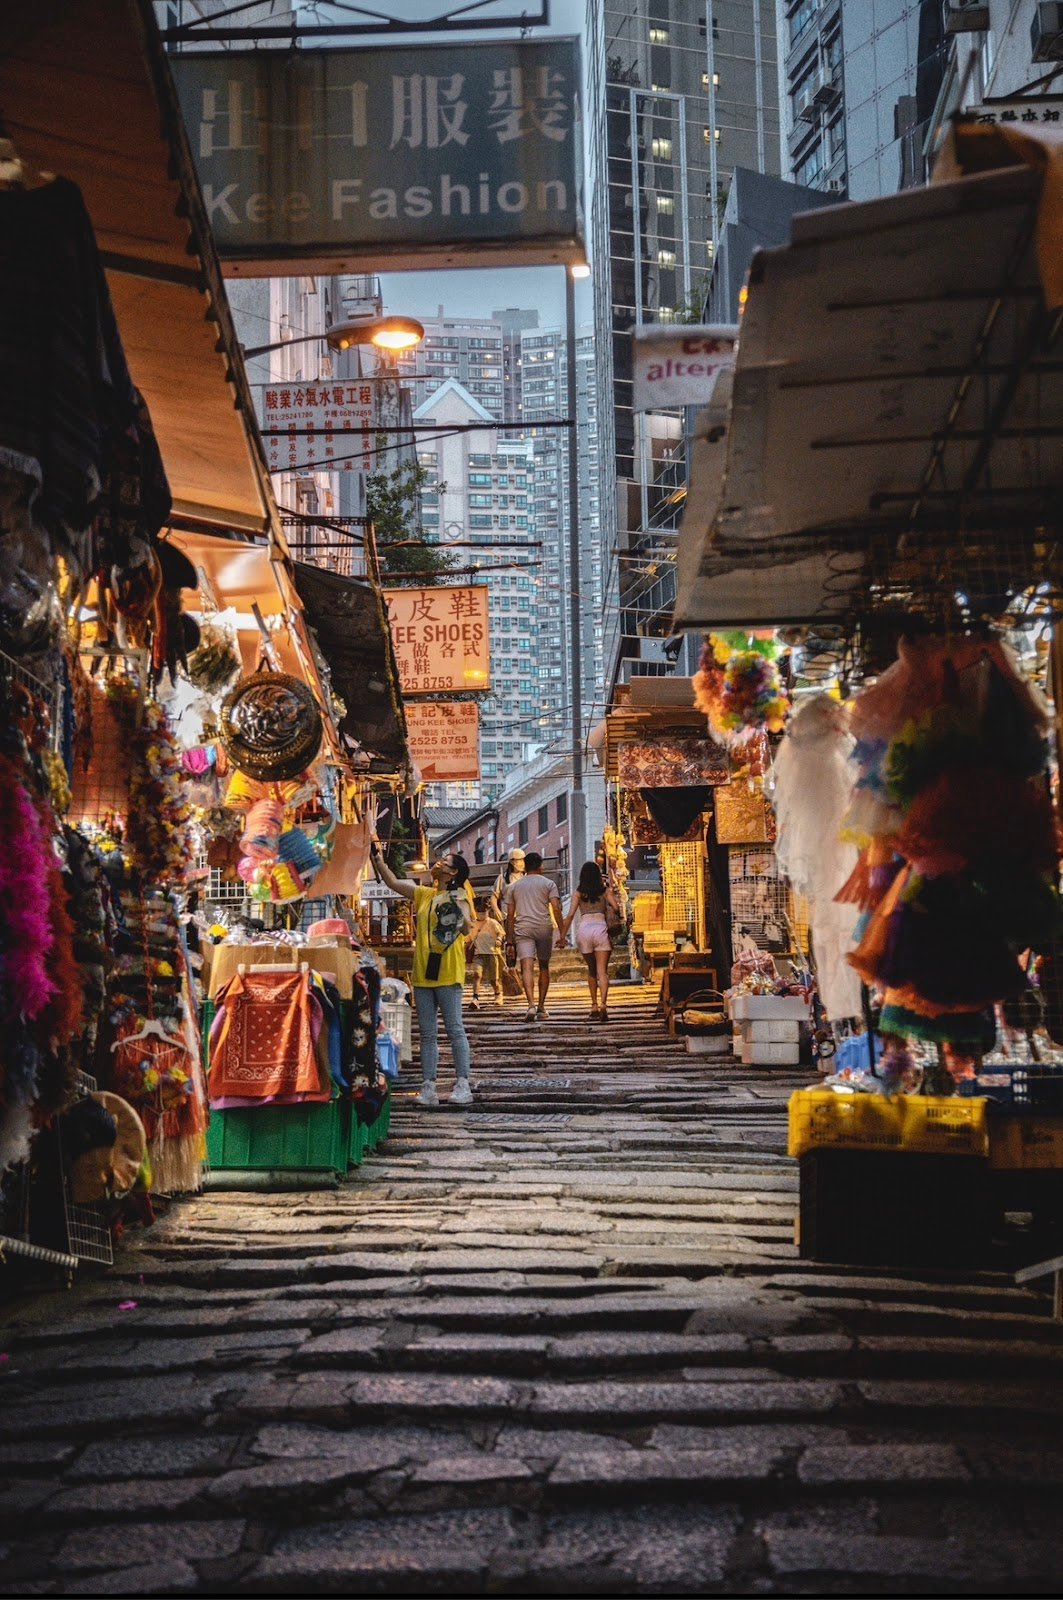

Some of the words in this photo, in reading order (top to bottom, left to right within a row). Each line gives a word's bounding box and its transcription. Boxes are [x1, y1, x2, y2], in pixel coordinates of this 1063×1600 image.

[203, 182, 312, 226] Kee
[331, 172, 568, 221] Fashion
[646, 358, 730, 382] alter
[391, 625, 417, 645] EE
[423, 622, 483, 643] SHOES
[400, 677, 419, 691] 25
[423, 676, 453, 689] 8753
[407, 719, 425, 727] UNG
[447, 718, 476, 726] SHOES
[410, 737, 438, 745] 2525
[441, 735, 468, 745] 8753
